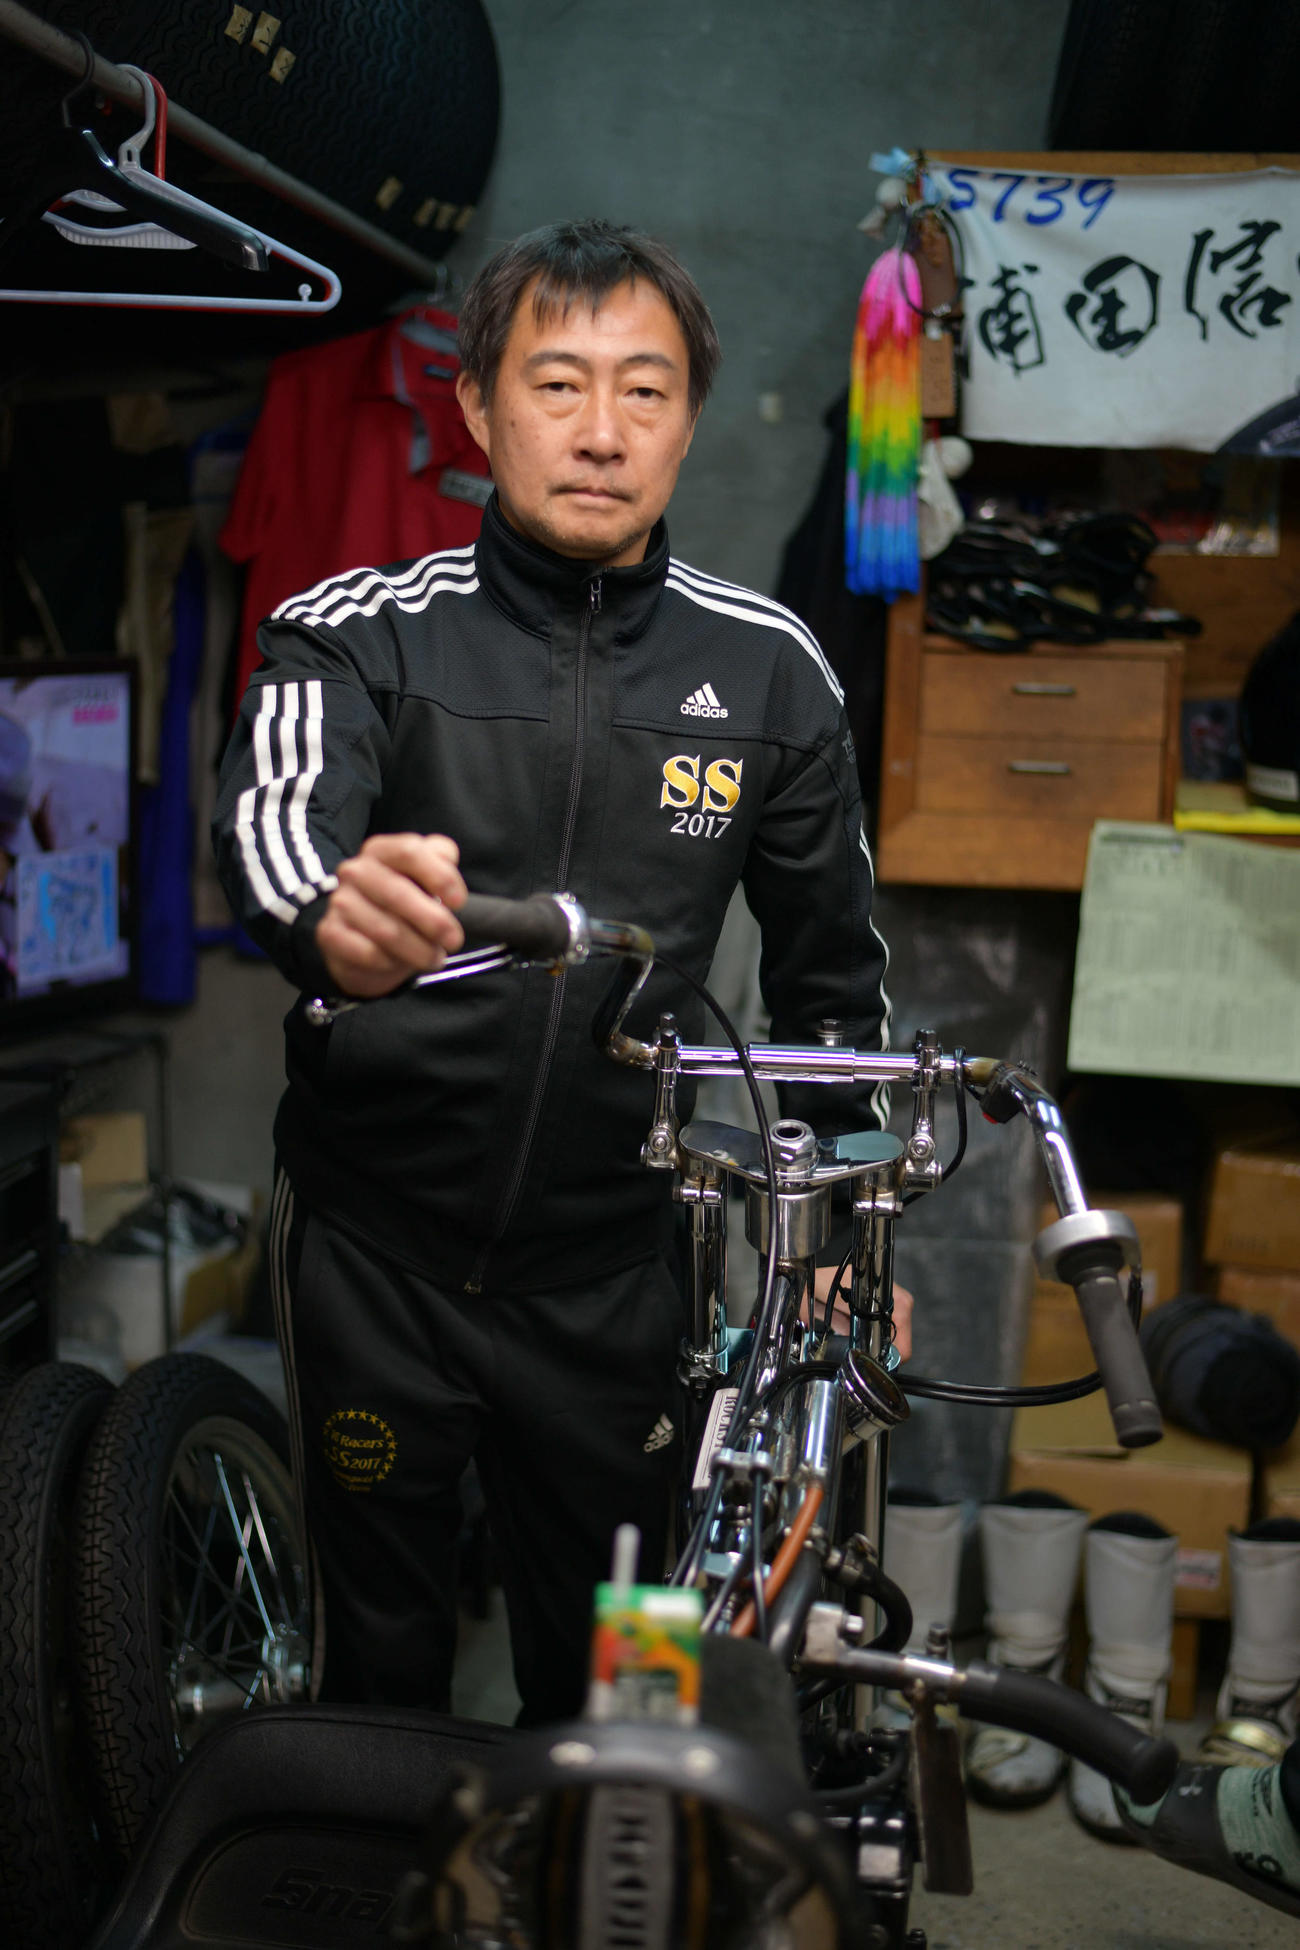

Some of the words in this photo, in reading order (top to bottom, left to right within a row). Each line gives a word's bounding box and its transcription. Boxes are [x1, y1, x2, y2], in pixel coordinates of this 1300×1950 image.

[680, 702, 729, 719] adidas
[659, 753, 744, 813] SS
[670, 811, 732, 839] 2017
[350, 1457, 382, 1471] 2017
